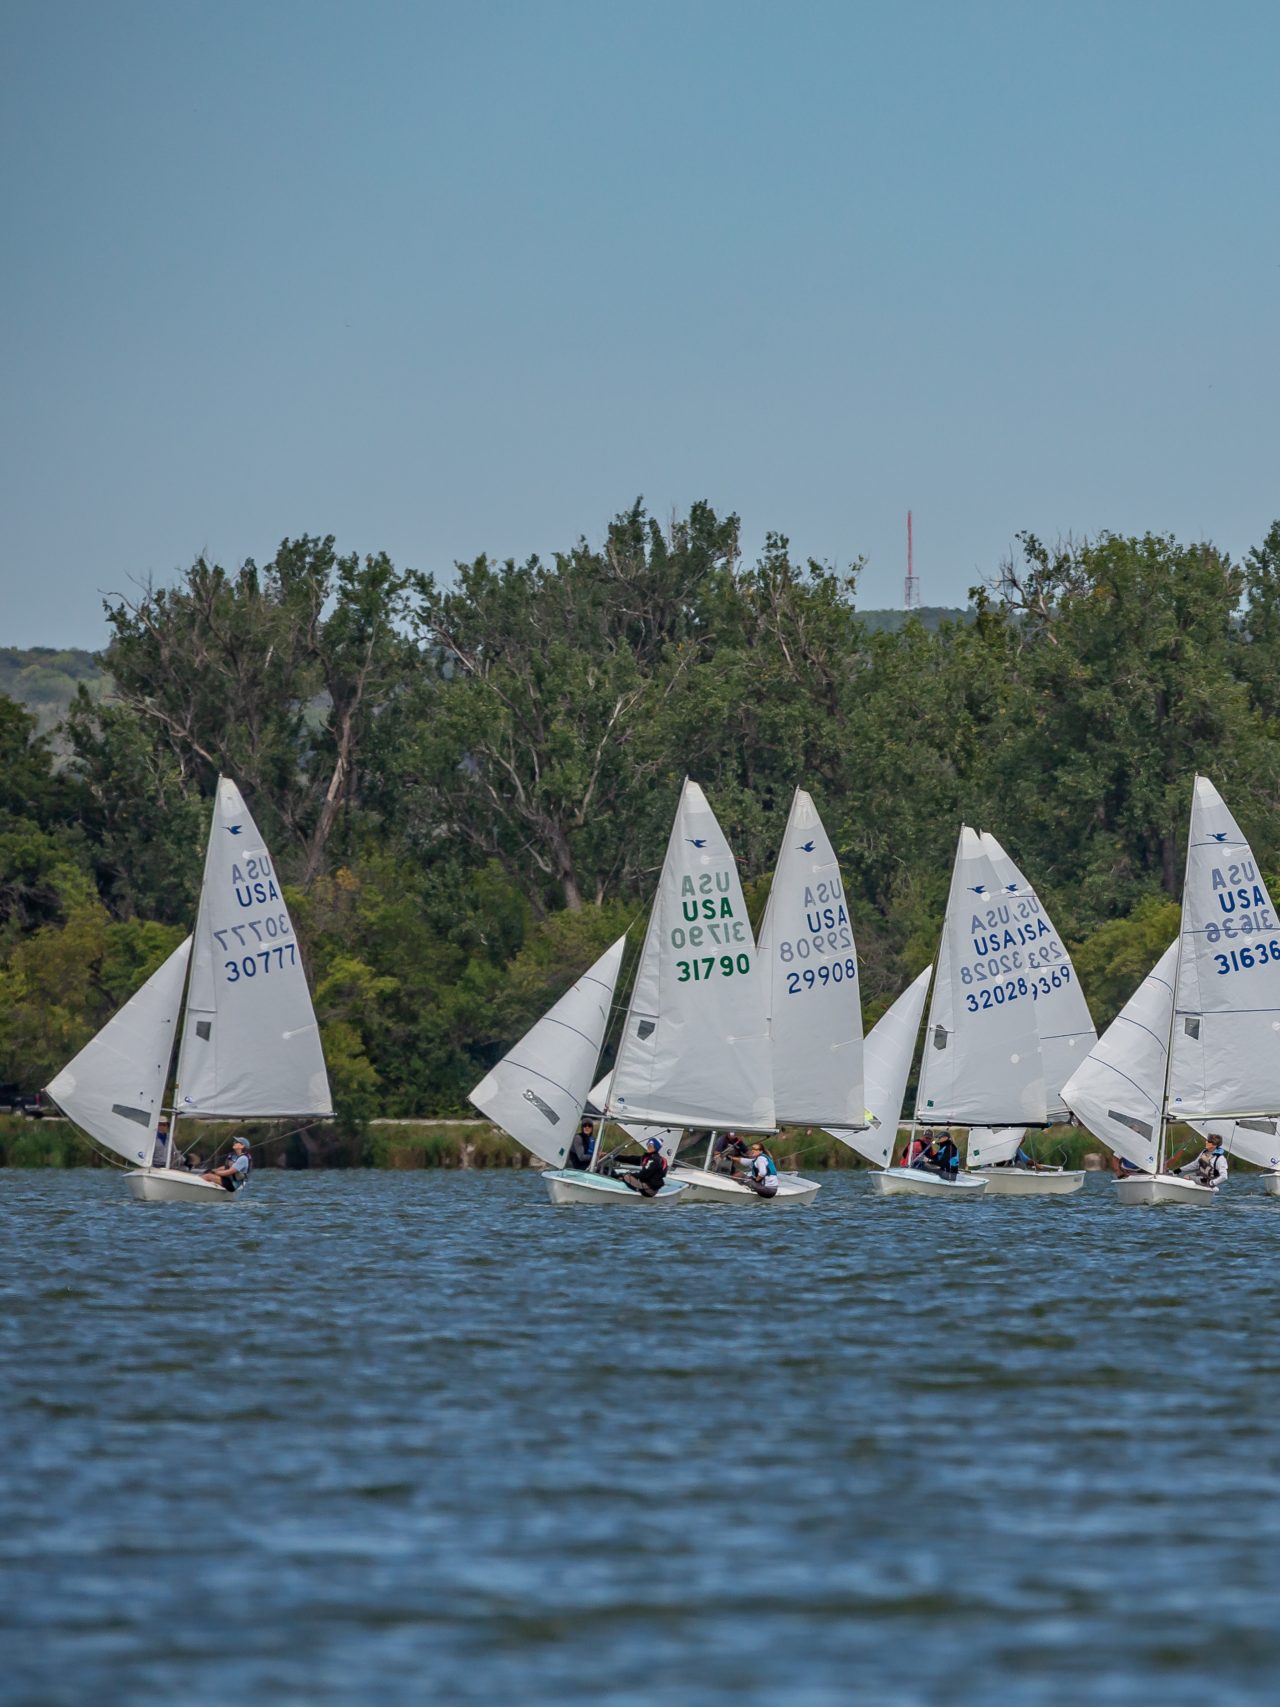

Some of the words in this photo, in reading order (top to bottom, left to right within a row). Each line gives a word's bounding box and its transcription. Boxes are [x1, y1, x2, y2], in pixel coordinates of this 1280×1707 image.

[236, 880, 279, 907] USA
[1218, 885, 1265, 913] USA
[682, 897, 733, 921] USA
[806, 905, 847, 933] USA
[973, 929, 1017, 956] USA
[224, 944, 295, 982] 30777
[676, 953, 750, 982] 31790
[786, 959, 855, 994] 29908
[966, 977, 1028, 1012] 32028
